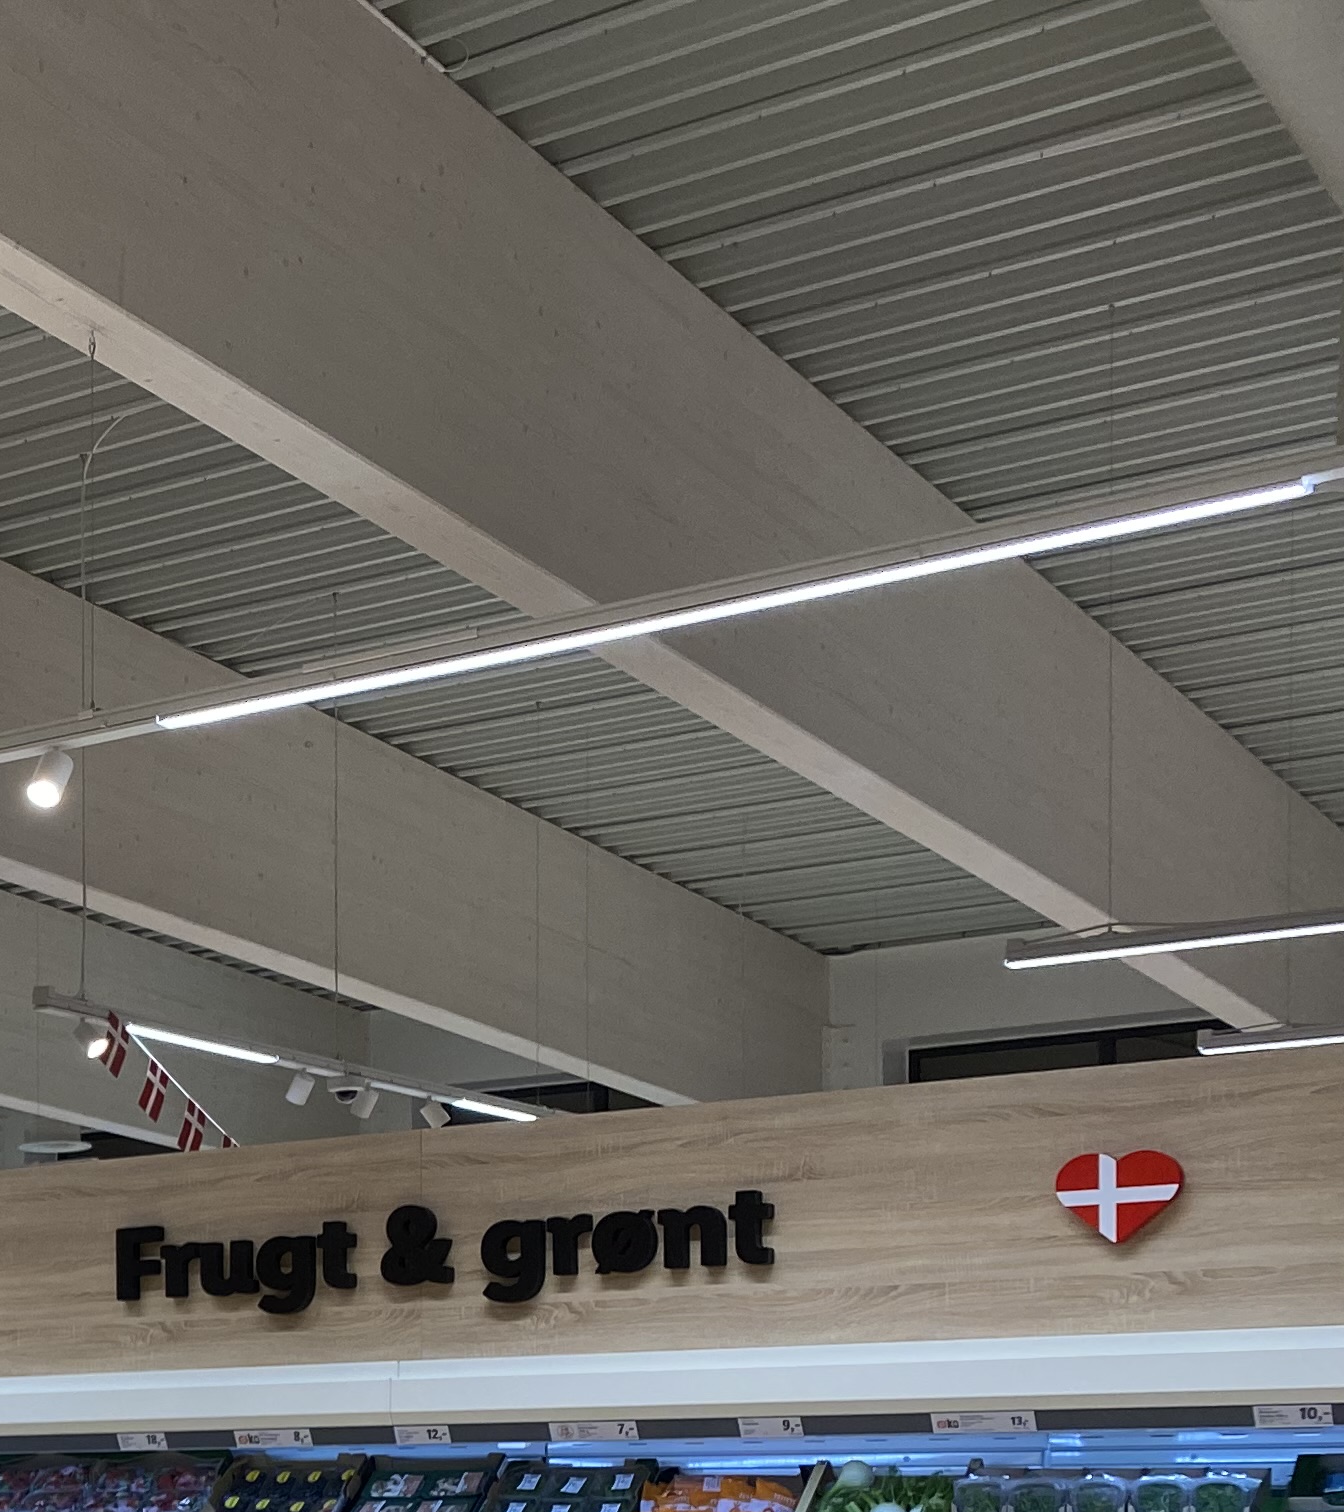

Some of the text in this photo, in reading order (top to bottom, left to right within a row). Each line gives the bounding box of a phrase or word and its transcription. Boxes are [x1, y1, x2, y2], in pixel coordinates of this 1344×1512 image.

[115, 1191, 774, 1313] Frugt & grønt
[1299, 1407, 1330, 1421] 10,-
[616, 1423, 634, 1437] 7,-
[782, 1419, 801, 1434] 9,-
[426, 1428, 447, 1442] 12,-
